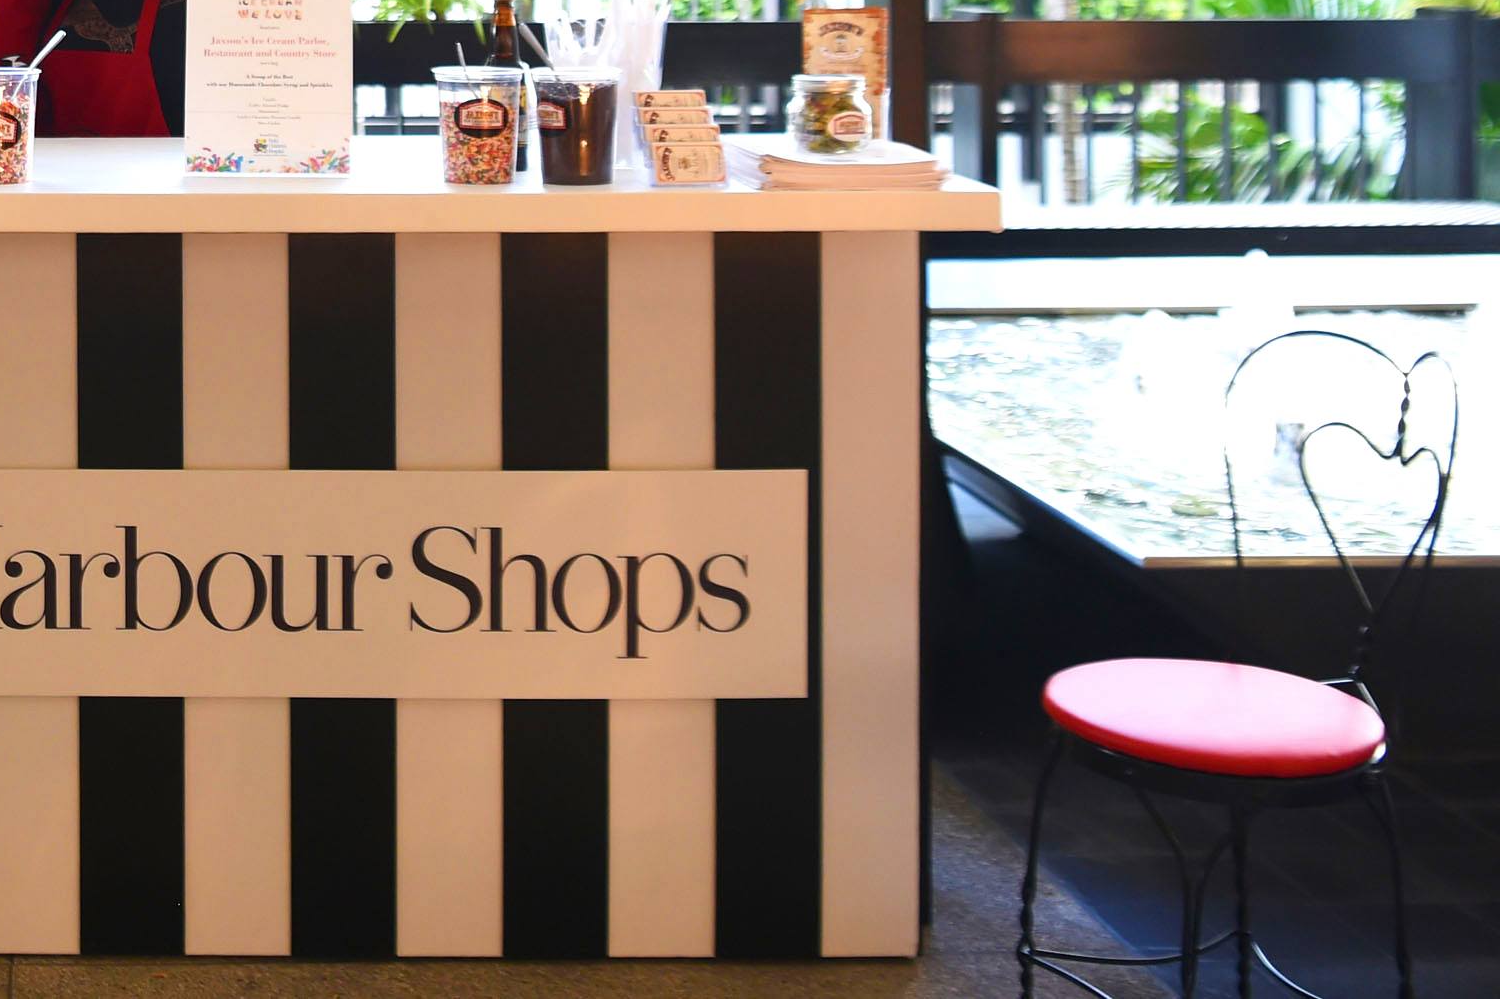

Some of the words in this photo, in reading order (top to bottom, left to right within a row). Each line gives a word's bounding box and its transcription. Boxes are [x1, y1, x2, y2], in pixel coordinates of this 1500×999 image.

[237, 8, 260, 19] WE
[264, 8, 303, 21] LOVE
[210, 35, 249, 45] Jaxson's
[251, 35, 265, 45] Ice
[267, 35, 296, 45] Cream
[203, 48, 253, 58] Restaurant
[255, 48, 273, 58] and
[275, 48, 311, 61] Country
[313, 48, 338, 58] Store
[409, 524, 752, 660] Shops
